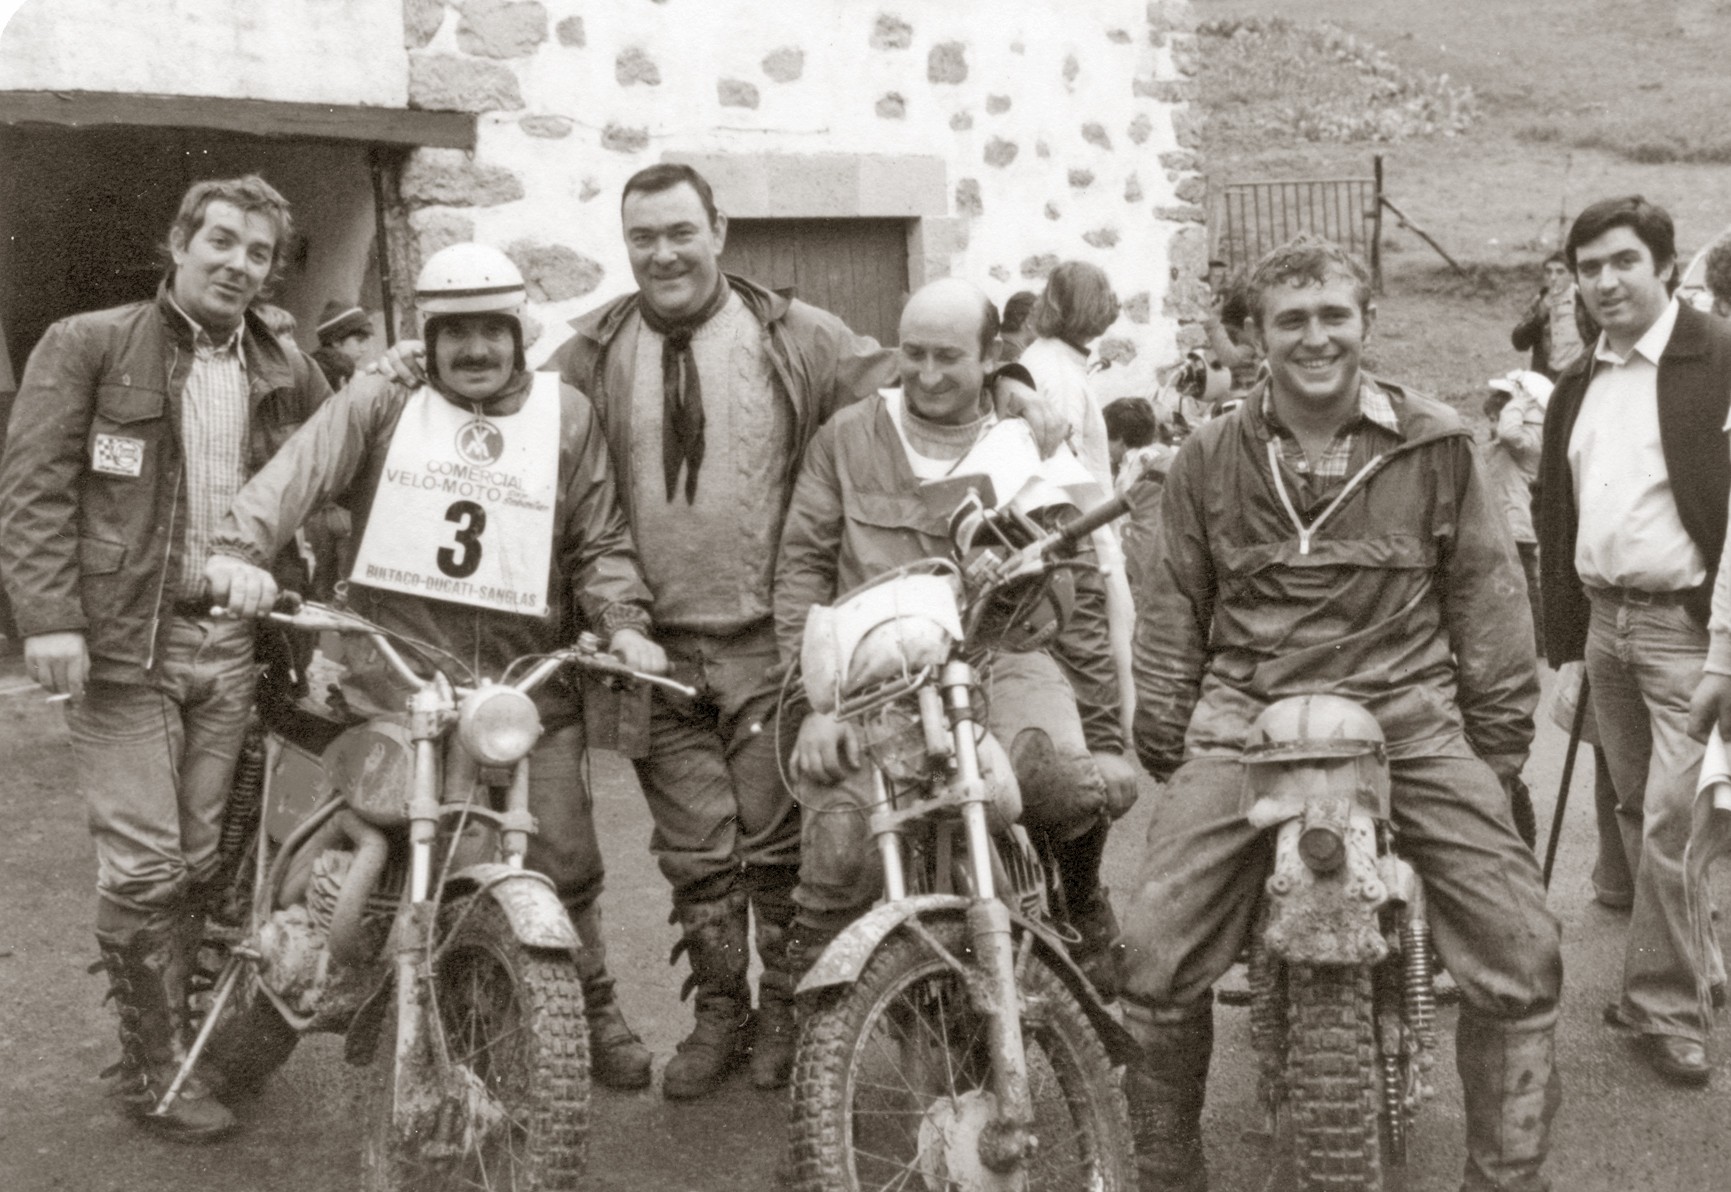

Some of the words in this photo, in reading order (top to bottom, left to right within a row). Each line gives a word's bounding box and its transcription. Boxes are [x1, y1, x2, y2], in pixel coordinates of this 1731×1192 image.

[386, 468, 500, 502] VELO-MOTO
[426, 460, 523, 490] COMERCIAL
[436, 500, 486, 579] 3
